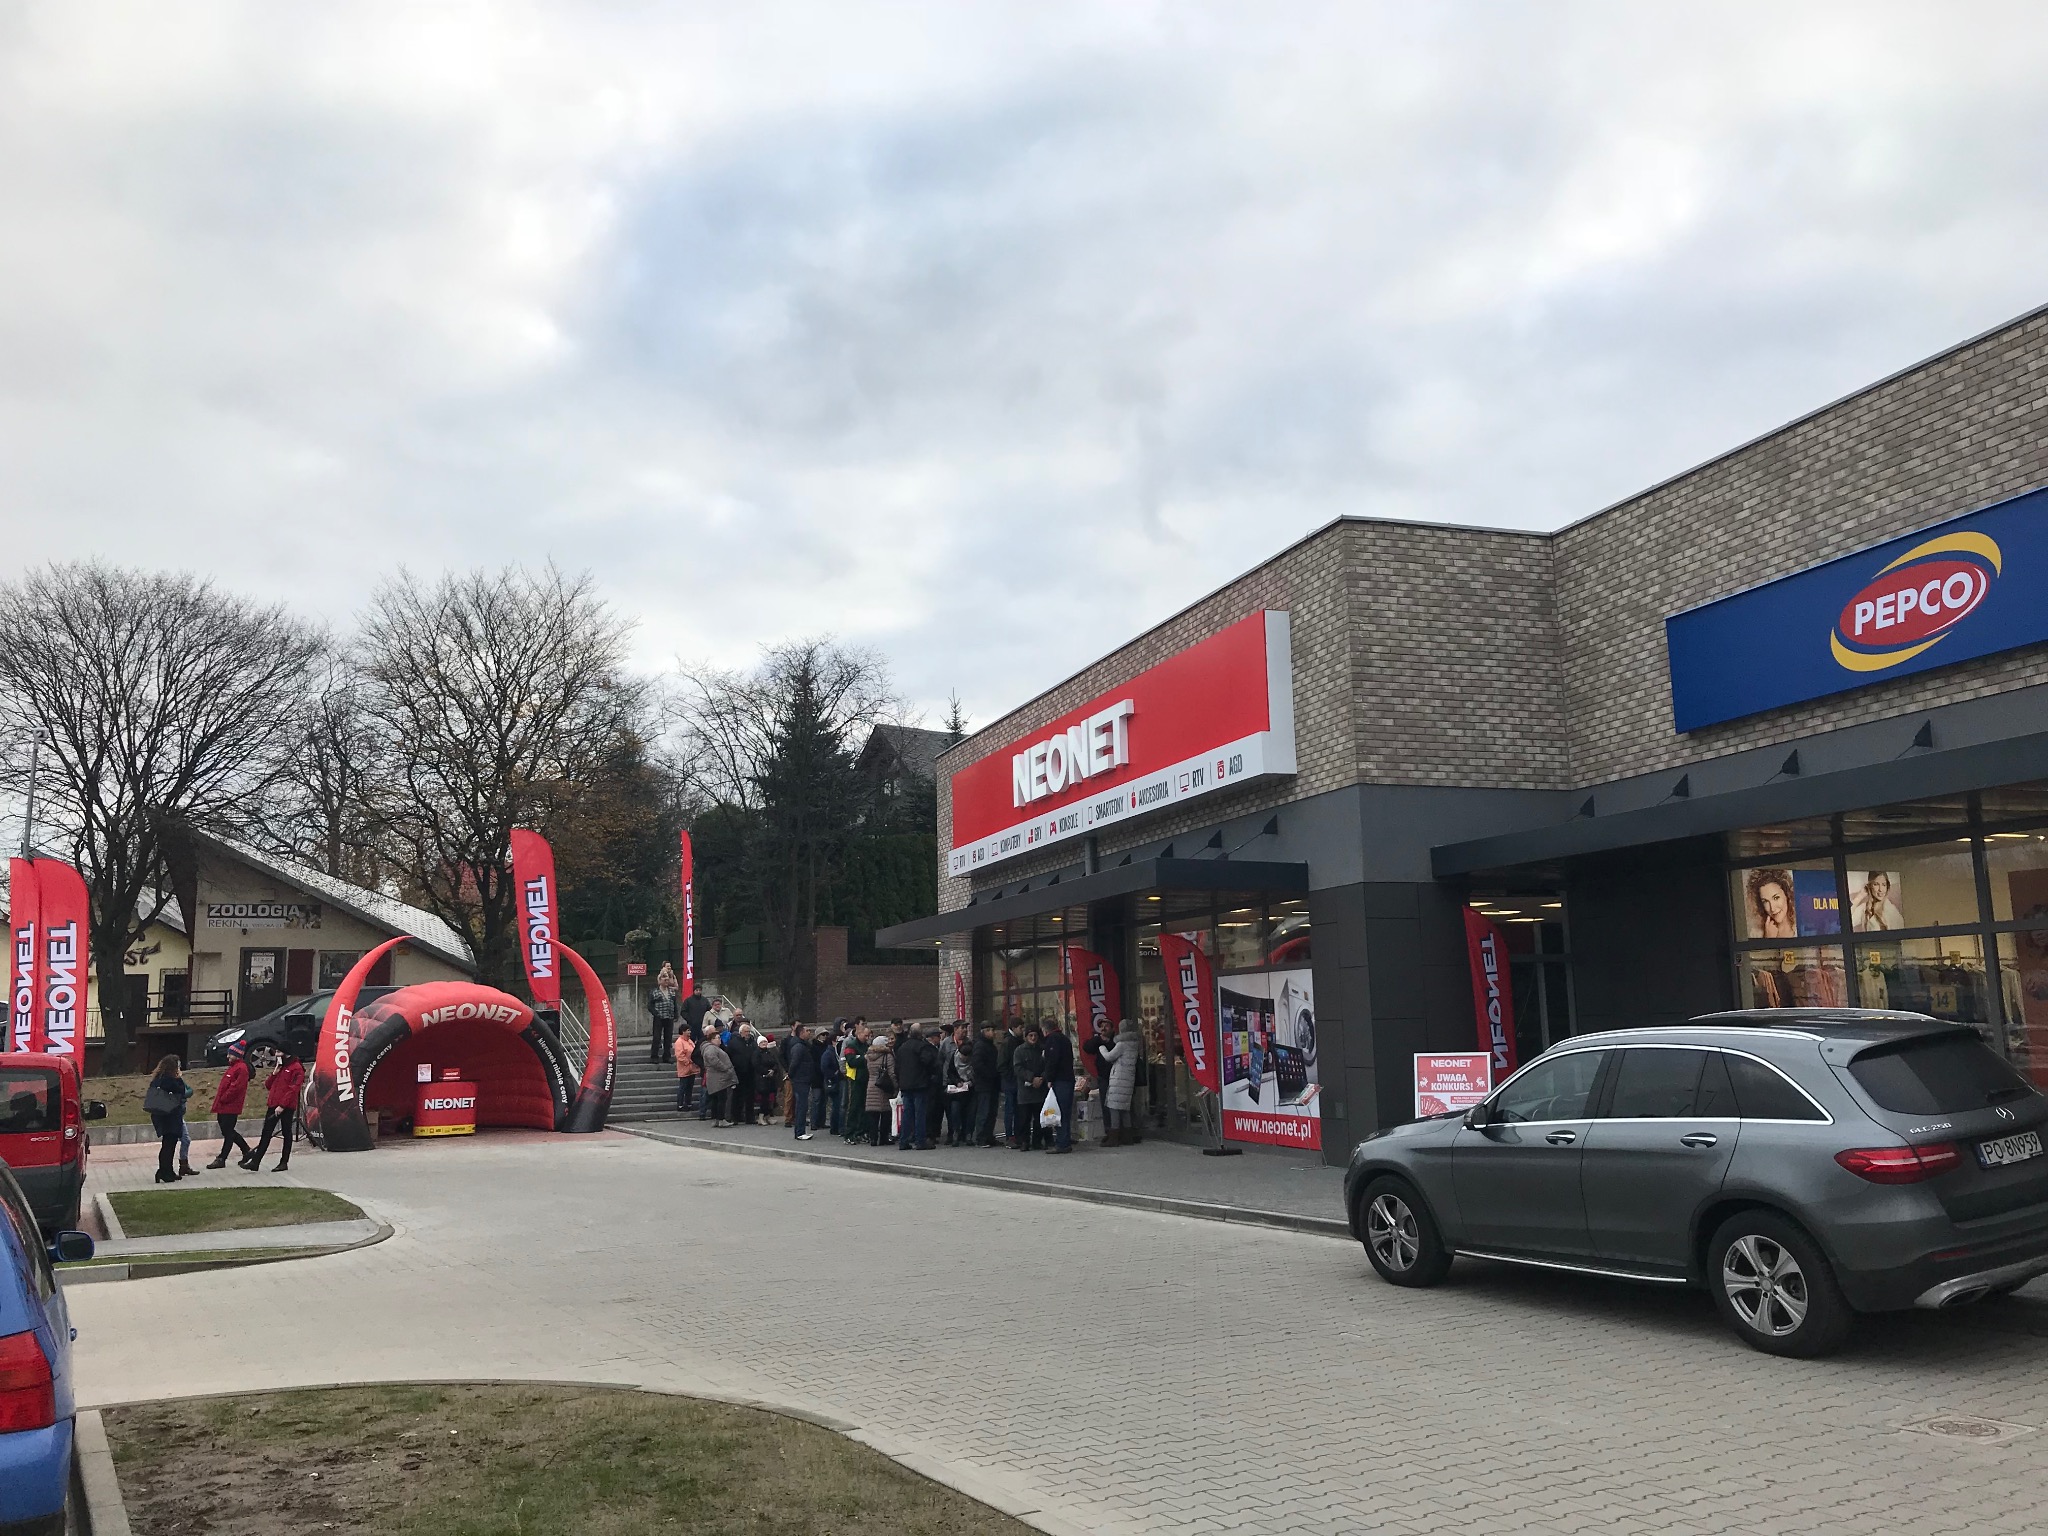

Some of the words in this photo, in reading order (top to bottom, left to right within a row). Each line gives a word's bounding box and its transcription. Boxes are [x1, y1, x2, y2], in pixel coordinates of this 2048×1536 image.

[1855, 572, 1973, 635] PEPCO
[1013, 699, 1134, 808] NEONET
[1000, 833, 1021, 852] KOMPUTERY
[1034, 825, 1042, 841] GRY
[1059, 813, 1079, 832] KONSOLE
[1095, 796, 1124, 820] SMARTFONY
[1138, 781, 1169, 806] AKCESORIA
[1193, 768, 1204, 788] RTV
[1229, 754, 1243, 776] AGD
[209, 904, 300, 917] ZOOLOGIA
[1813, 898, 1828, 909] DLA
[1829, 898, 1839, 909] NI
[208, 919, 243, 928] REKIN
[421, 1003, 522, 1028] NEONET
[602, 999, 614, 1048] zapraszamy
[335, 1004, 354, 1102] NEONET
[363, 1060, 377, 1083] niskie
[377, 1043, 392, 1060] ceny
[608, 1050, 614, 1062] do
[1431, 1060, 1472, 1068] NEONET
[538, 1037, 557, 1064] kierunek
[553, 1063, 564, 1085] niskie
[560, 1085, 568, 1104] ceny
[605, 1063, 614, 1091] sklepu
[1436, 1073, 1468, 1082] UWAGA
[1431, 1083, 1474, 1091] KONKURS!
[424, 1097, 476, 1110] NEONET
[1235, 1116, 1312, 1141] www.neonet.pl
[1931, 1122, 1952, 1131] 250
[1984, 1144, 2004, 1161] PO
[2004, 1133, 2039, 1157] 8N959
